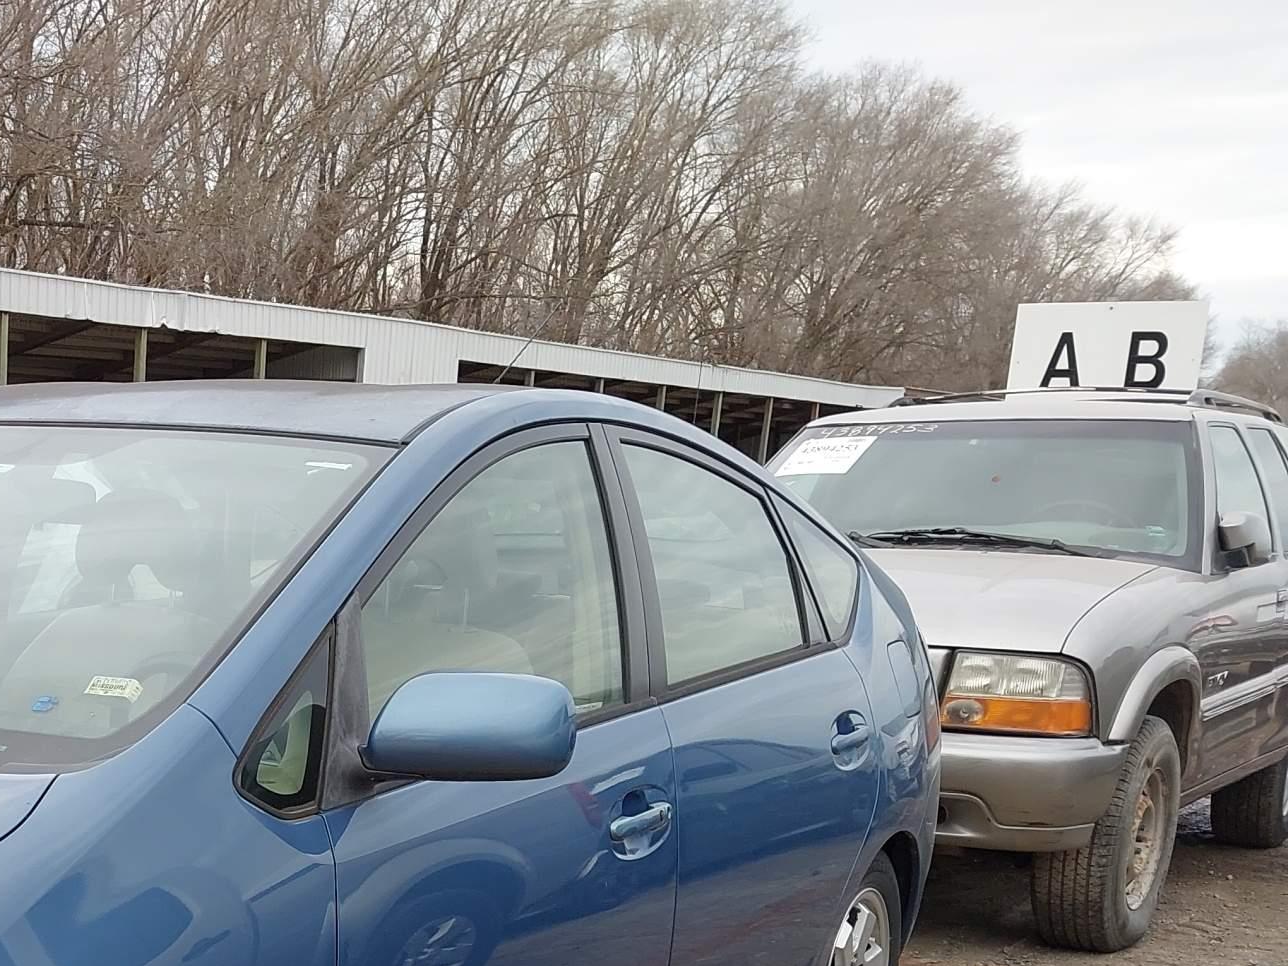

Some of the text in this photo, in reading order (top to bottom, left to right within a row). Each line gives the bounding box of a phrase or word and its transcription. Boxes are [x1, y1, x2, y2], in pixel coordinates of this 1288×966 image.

[1039, 331, 1169, 389] A B
[820, 424, 940, 440] 43894253
